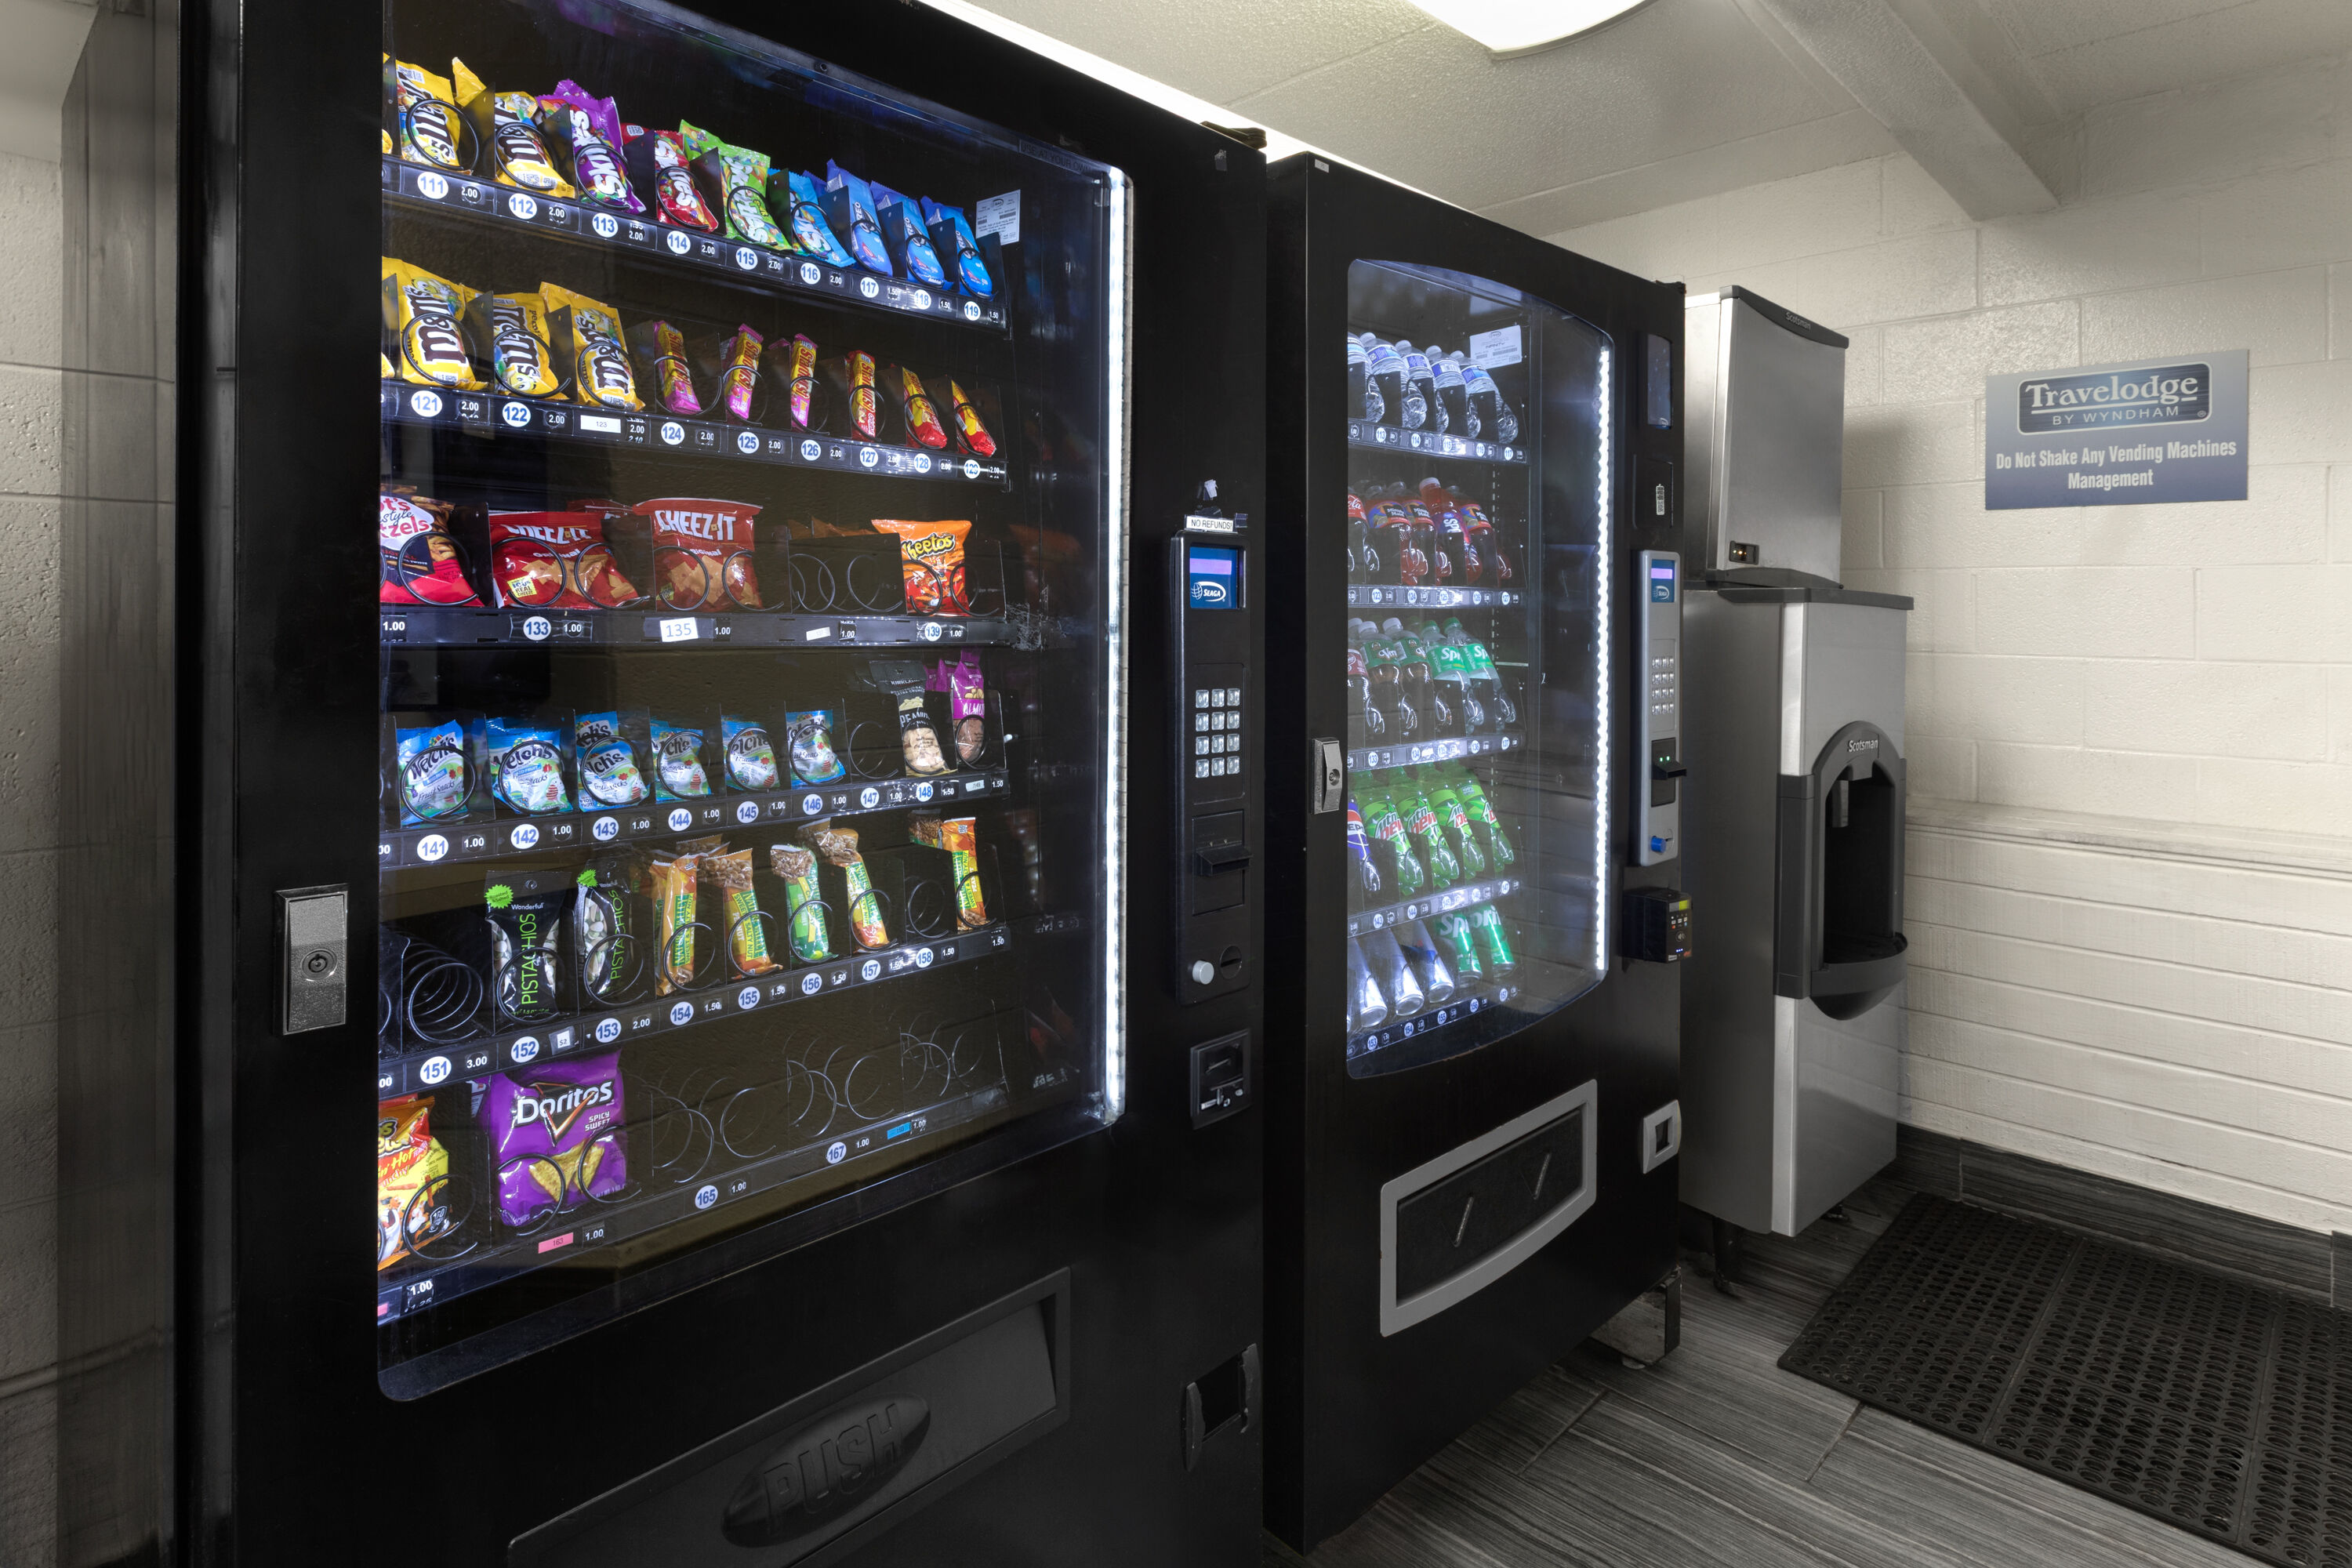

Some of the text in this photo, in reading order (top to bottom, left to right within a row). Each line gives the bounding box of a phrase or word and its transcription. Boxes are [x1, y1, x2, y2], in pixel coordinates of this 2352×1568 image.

[420, 177, 445, 194] 111
[461, 187, 477, 199] 2.00
[510, 198, 535, 214] 112
[549, 208, 564, 218] 2.00
[594, 216, 615, 233] 113
[629, 230, 644, 241] 2.00
[669, 236, 688, 250] 114
[702, 245, 715, 256] 2.00
[737, 251, 755, 264] 115
[768, 260, 781, 270] 2.00
[802, 267, 818, 280] 116
[830, 274, 842, 285] 2.00
[862, 281, 877, 294] 117
[887, 287, 898, 296] 1.50
[916, 293, 930, 307] 118
[940, 301, 950, 310] 1.50
[965, 305, 979, 318] 119
[1786, 312, 1811, 330] Scotsman
[2026, 376, 2198, 408] Travelodge
[415, 397, 439, 412] 121
[461, 401, 479, 412] 2.00
[505, 407, 528, 423] 122
[549, 415, 564, 424] 2.00
[2053, 406, 2179, 426] BY WYNDHAM
[630, 425, 644, 434] 2.00
[662, 426, 683, 441] 124
[701, 432, 714, 441] 2.00
[739, 435, 757, 450] 125
[768, 441, 781, 450] 2.00
[802, 444, 819, 457] 126
[830, 449, 842, 458] 2.00
[861, 451, 876, 463] 127
[1996, 440, 2237, 470] Do Not Shake Any Vending Machines
[915, 459, 929, 469] 128
[965, 463, 978, 475] 129
[2068, 469, 2154, 492] Management
[382, 510, 414, 525] style
[380, 516, 430, 538] tzels
[1202, 520, 1232, 530] REFUNDS!
[902, 535, 953, 561] heetos
[1203, 588, 1221, 597] SEAGA
[1373, 591, 1381, 600] 123
[382, 621, 405, 631] 1.00
[526, 622, 550, 636] 133
[564, 624, 582, 633] 1.00
[665, 623, 692, 637] 135
[714, 626, 731, 635] 1.00
[926, 626, 940, 637] 139
[1848, 739, 1878, 753] Scotsman
[1369, 754, 1377, 763] 133
[437, 780, 456, 793] Snacks
[993, 780, 1004, 789] 1.50
[862, 791, 878, 804] 147
[890, 792, 902, 800] 1.00
[917, 786, 932, 798] 148
[942, 787, 954, 796] 1.50
[772, 801, 786, 811] 1.00
[804, 798, 822, 811] 146
[833, 796, 846, 805] 1.00
[703, 810, 720, 819] 1.00
[739, 806, 757, 819] 145
[632, 820, 650, 829] 1.00
[670, 813, 690, 826] 144
[553, 825, 571, 836] 1.00
[595, 822, 616, 837] 143
[463, 837, 485, 848] 1.00
[514, 829, 537, 844] 142
[421, 840, 445, 855] 141
[732, 913, 745, 941] PENUT
[745, 922, 753, 942] SALTY
[993, 937, 1004, 946] 1.50
[519, 913, 539, 1004] PISTACHIOS
[917, 952, 931, 964] 158
[942, 948, 954, 956] 1.50
[863, 964, 878, 977] 157
[889, 960, 902, 970] 1.50
[804, 977, 820, 991] 156
[832, 973, 846, 983] 1.50
[771, 985, 785, 996] 1.50
[740, 991, 757, 1006] 155
[672, 1006, 691, 1021] 154
[705, 1002, 720, 1012] 1.50
[633, 1018, 650, 1029] 2.00
[1438, 1013, 1446, 1022] 155
[597, 1023, 619, 1037] 153
[1405, 1025, 1414, 1033] 154
[1368, 1039, 1377, 1047] 153
[514, 1042, 536, 1058] 152
[466, 1055, 487, 1068] 3.00
[423, 1062, 448, 1078] 151
[517, 1080, 613, 1124] Doritos
[590, 1110, 610, 1123] SPICY
[585, 1117, 611, 1132] SWEET
[913, 1120, 926, 1129] 1.00
[856, 1138, 869, 1148] 1.00
[390, 1150, 415, 1168] Hot
[829, 1145, 844, 1160] 167
[381, 1166, 410, 1187] unchy
[731, 1181, 746, 1193] 1.00
[697, 1189, 716, 1206] 165
[585, 1229, 604, 1240] 1.00
[552, 1237, 564, 1247] 163
[410, 1280, 433, 1294] 1.00
[764, 1403, 902, 1534] PUSH
